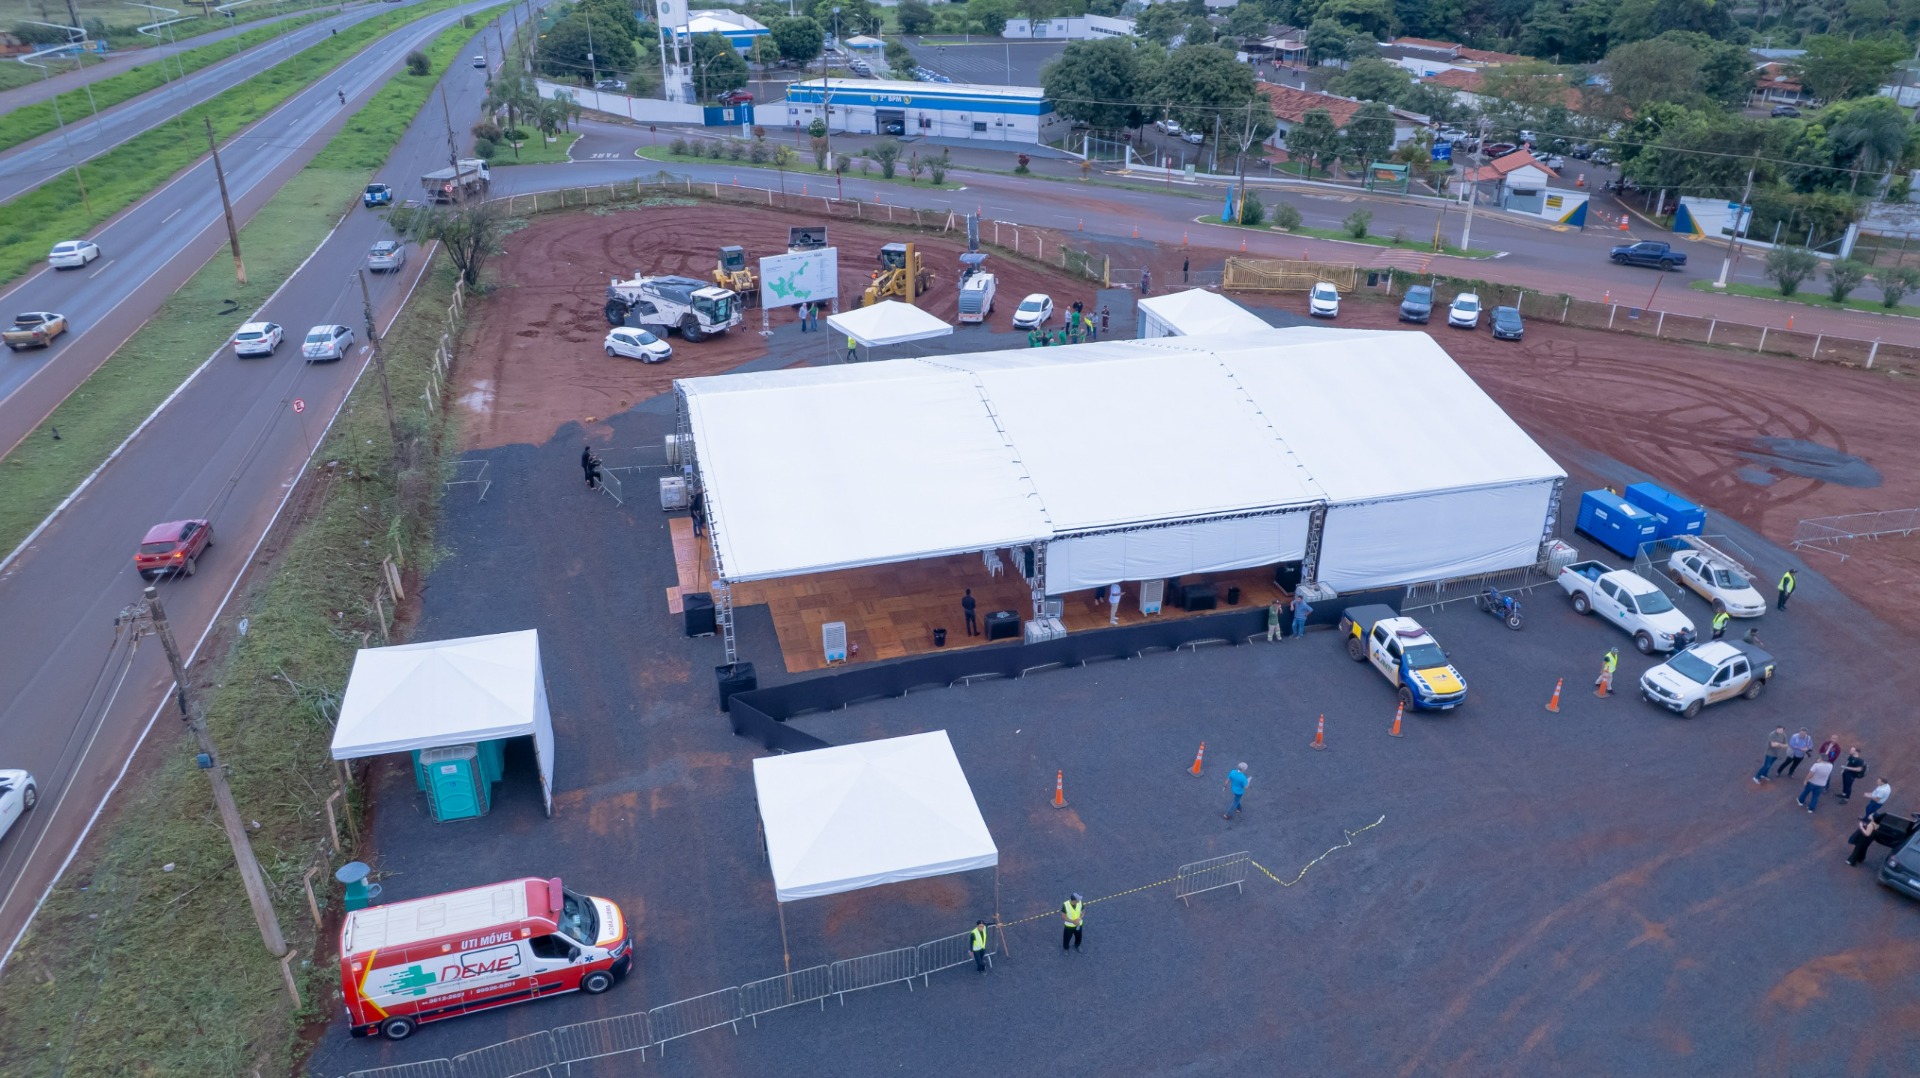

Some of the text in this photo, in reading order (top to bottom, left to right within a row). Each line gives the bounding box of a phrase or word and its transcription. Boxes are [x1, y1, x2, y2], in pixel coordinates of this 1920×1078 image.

[461, 931, 514, 950] UTI MÓVEL
[440, 956, 514, 982] DEME
